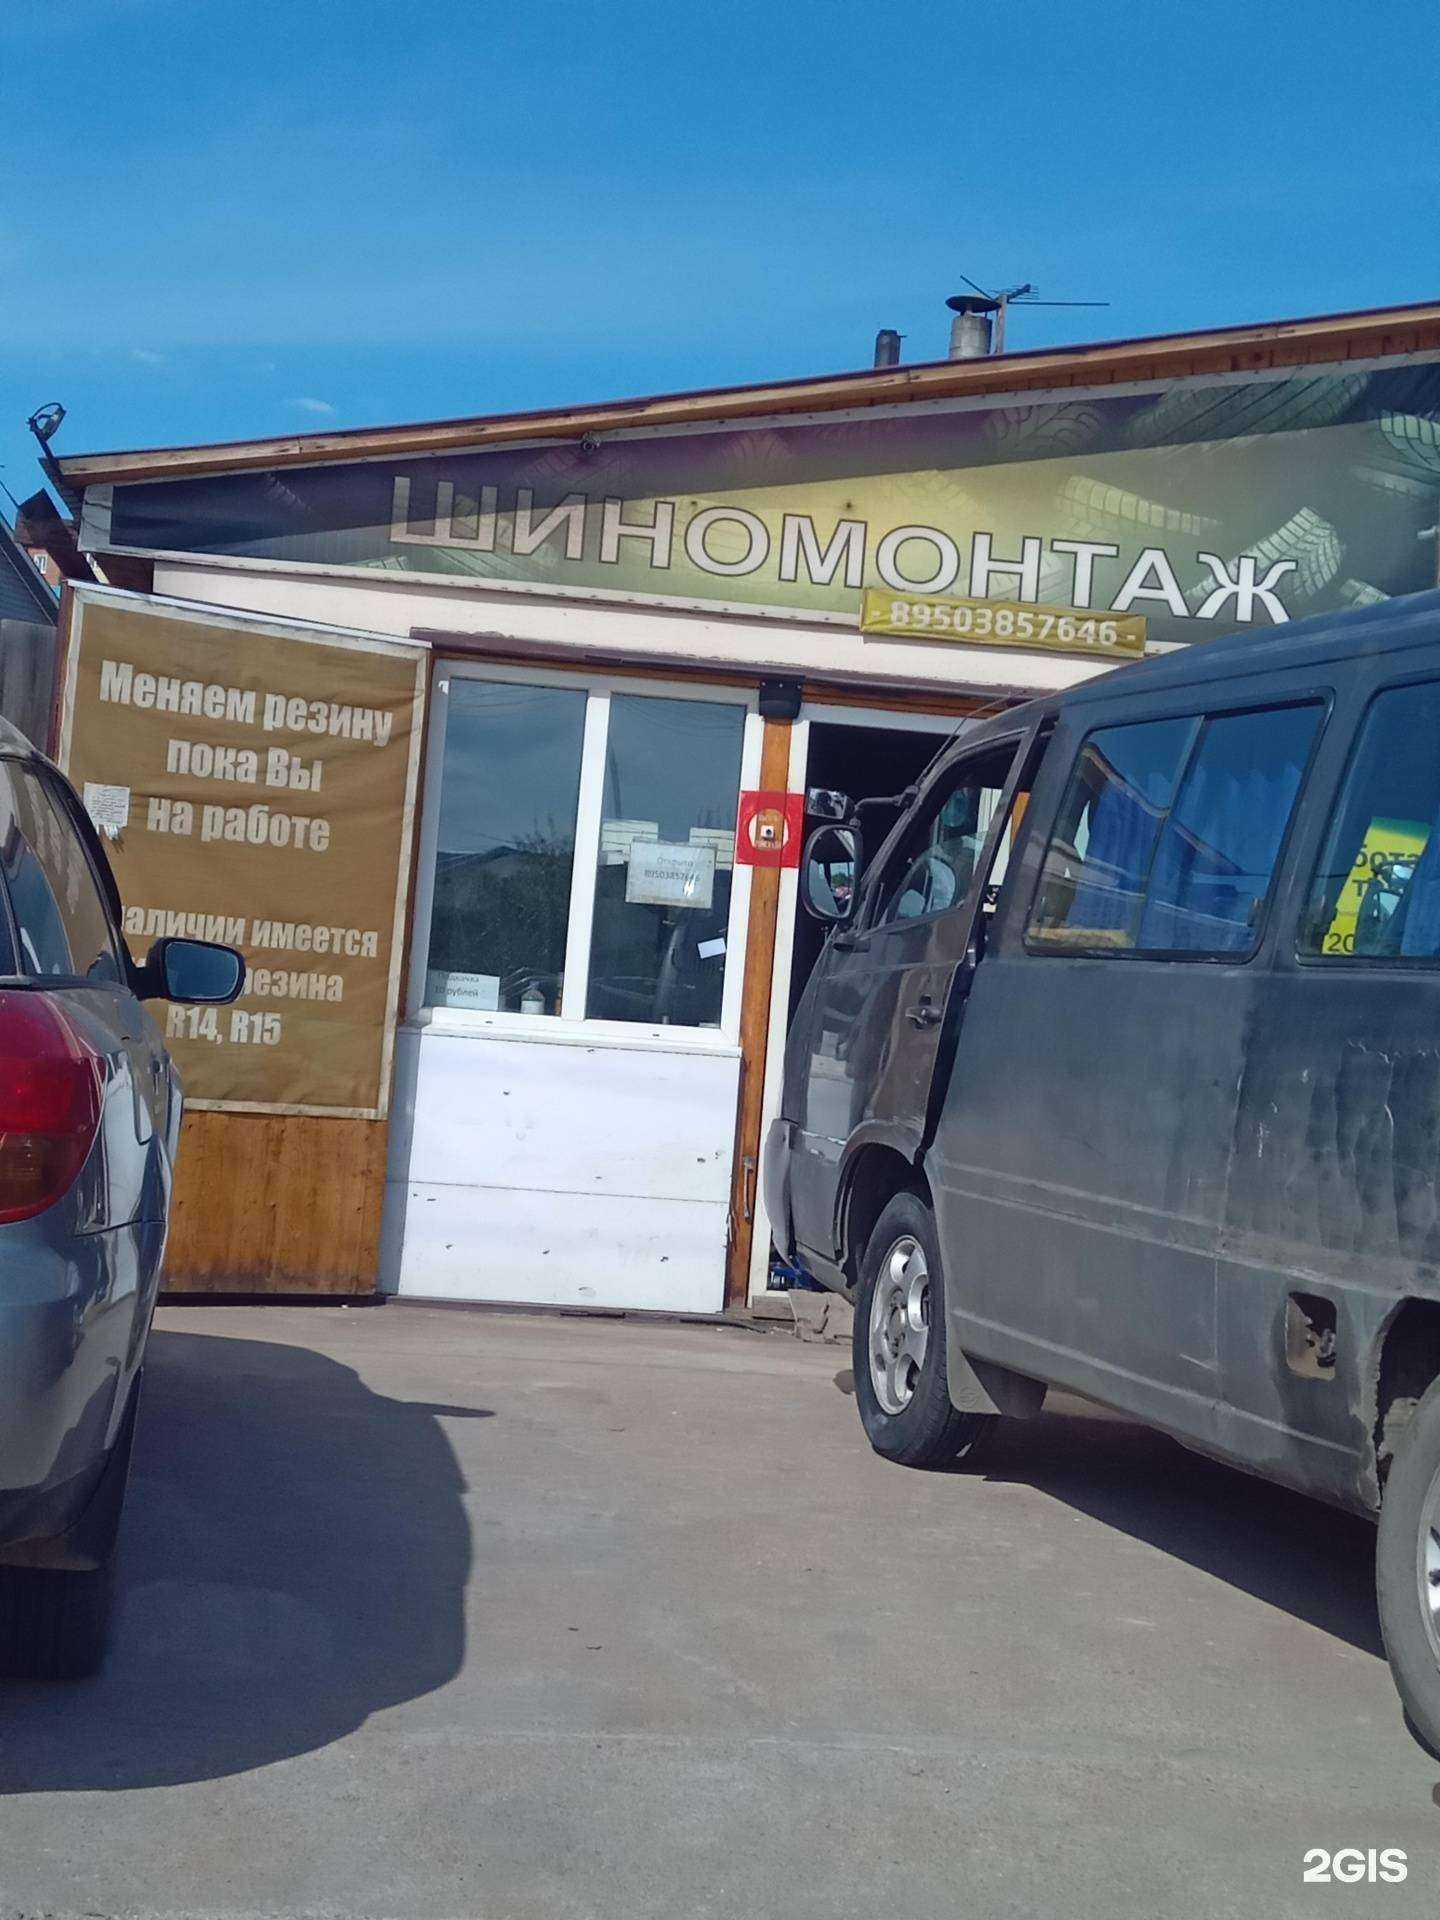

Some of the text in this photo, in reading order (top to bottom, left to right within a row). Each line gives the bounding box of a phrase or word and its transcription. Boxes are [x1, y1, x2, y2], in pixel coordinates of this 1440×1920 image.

[390, 475, 1297, 624] ШИНОМОНТАЖ
[890, 601, 1117, 645] 89503857646
[100, 659, 393, 747] Меняем резину
[166, 739, 323, 792] пока Вы
[147, 797, 194, 836] на
[201, 803, 330, 851] работе
[121, 904, 378, 958] аличии имеется
[165, 1004, 282, 1046] R14, R15
